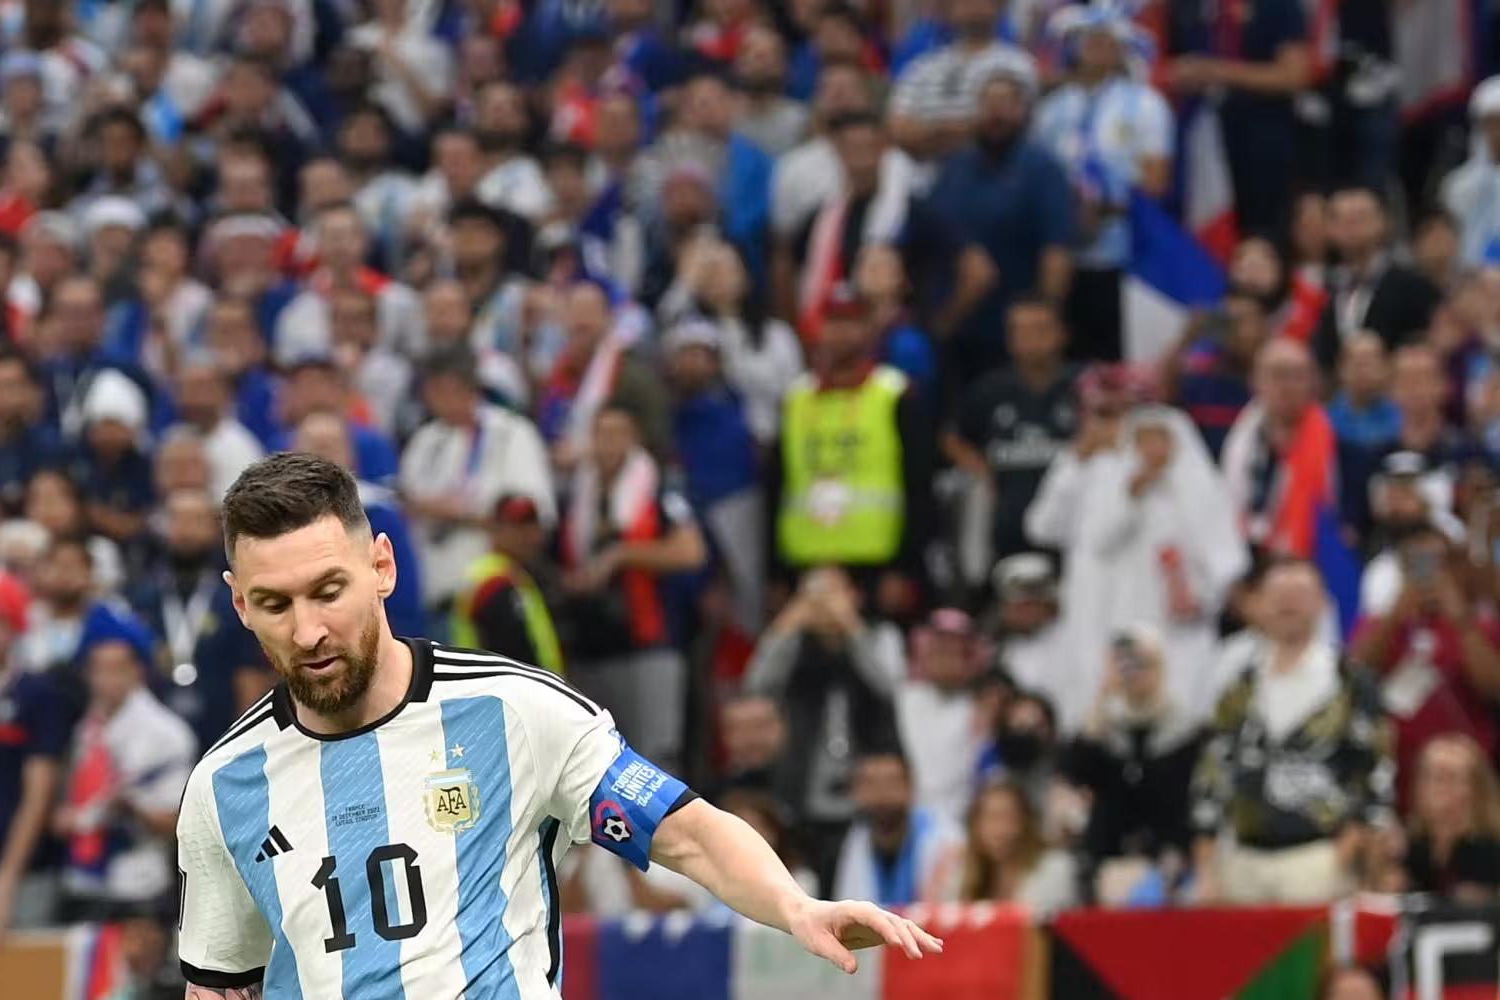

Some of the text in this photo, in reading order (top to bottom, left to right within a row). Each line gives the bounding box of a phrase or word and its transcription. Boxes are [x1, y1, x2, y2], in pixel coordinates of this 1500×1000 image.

[611, 760, 643, 794] FOOTBALL
[621, 765, 656, 801] UNITES
[437, 786, 467, 815] AFA
[311, 843, 428, 953] 10
